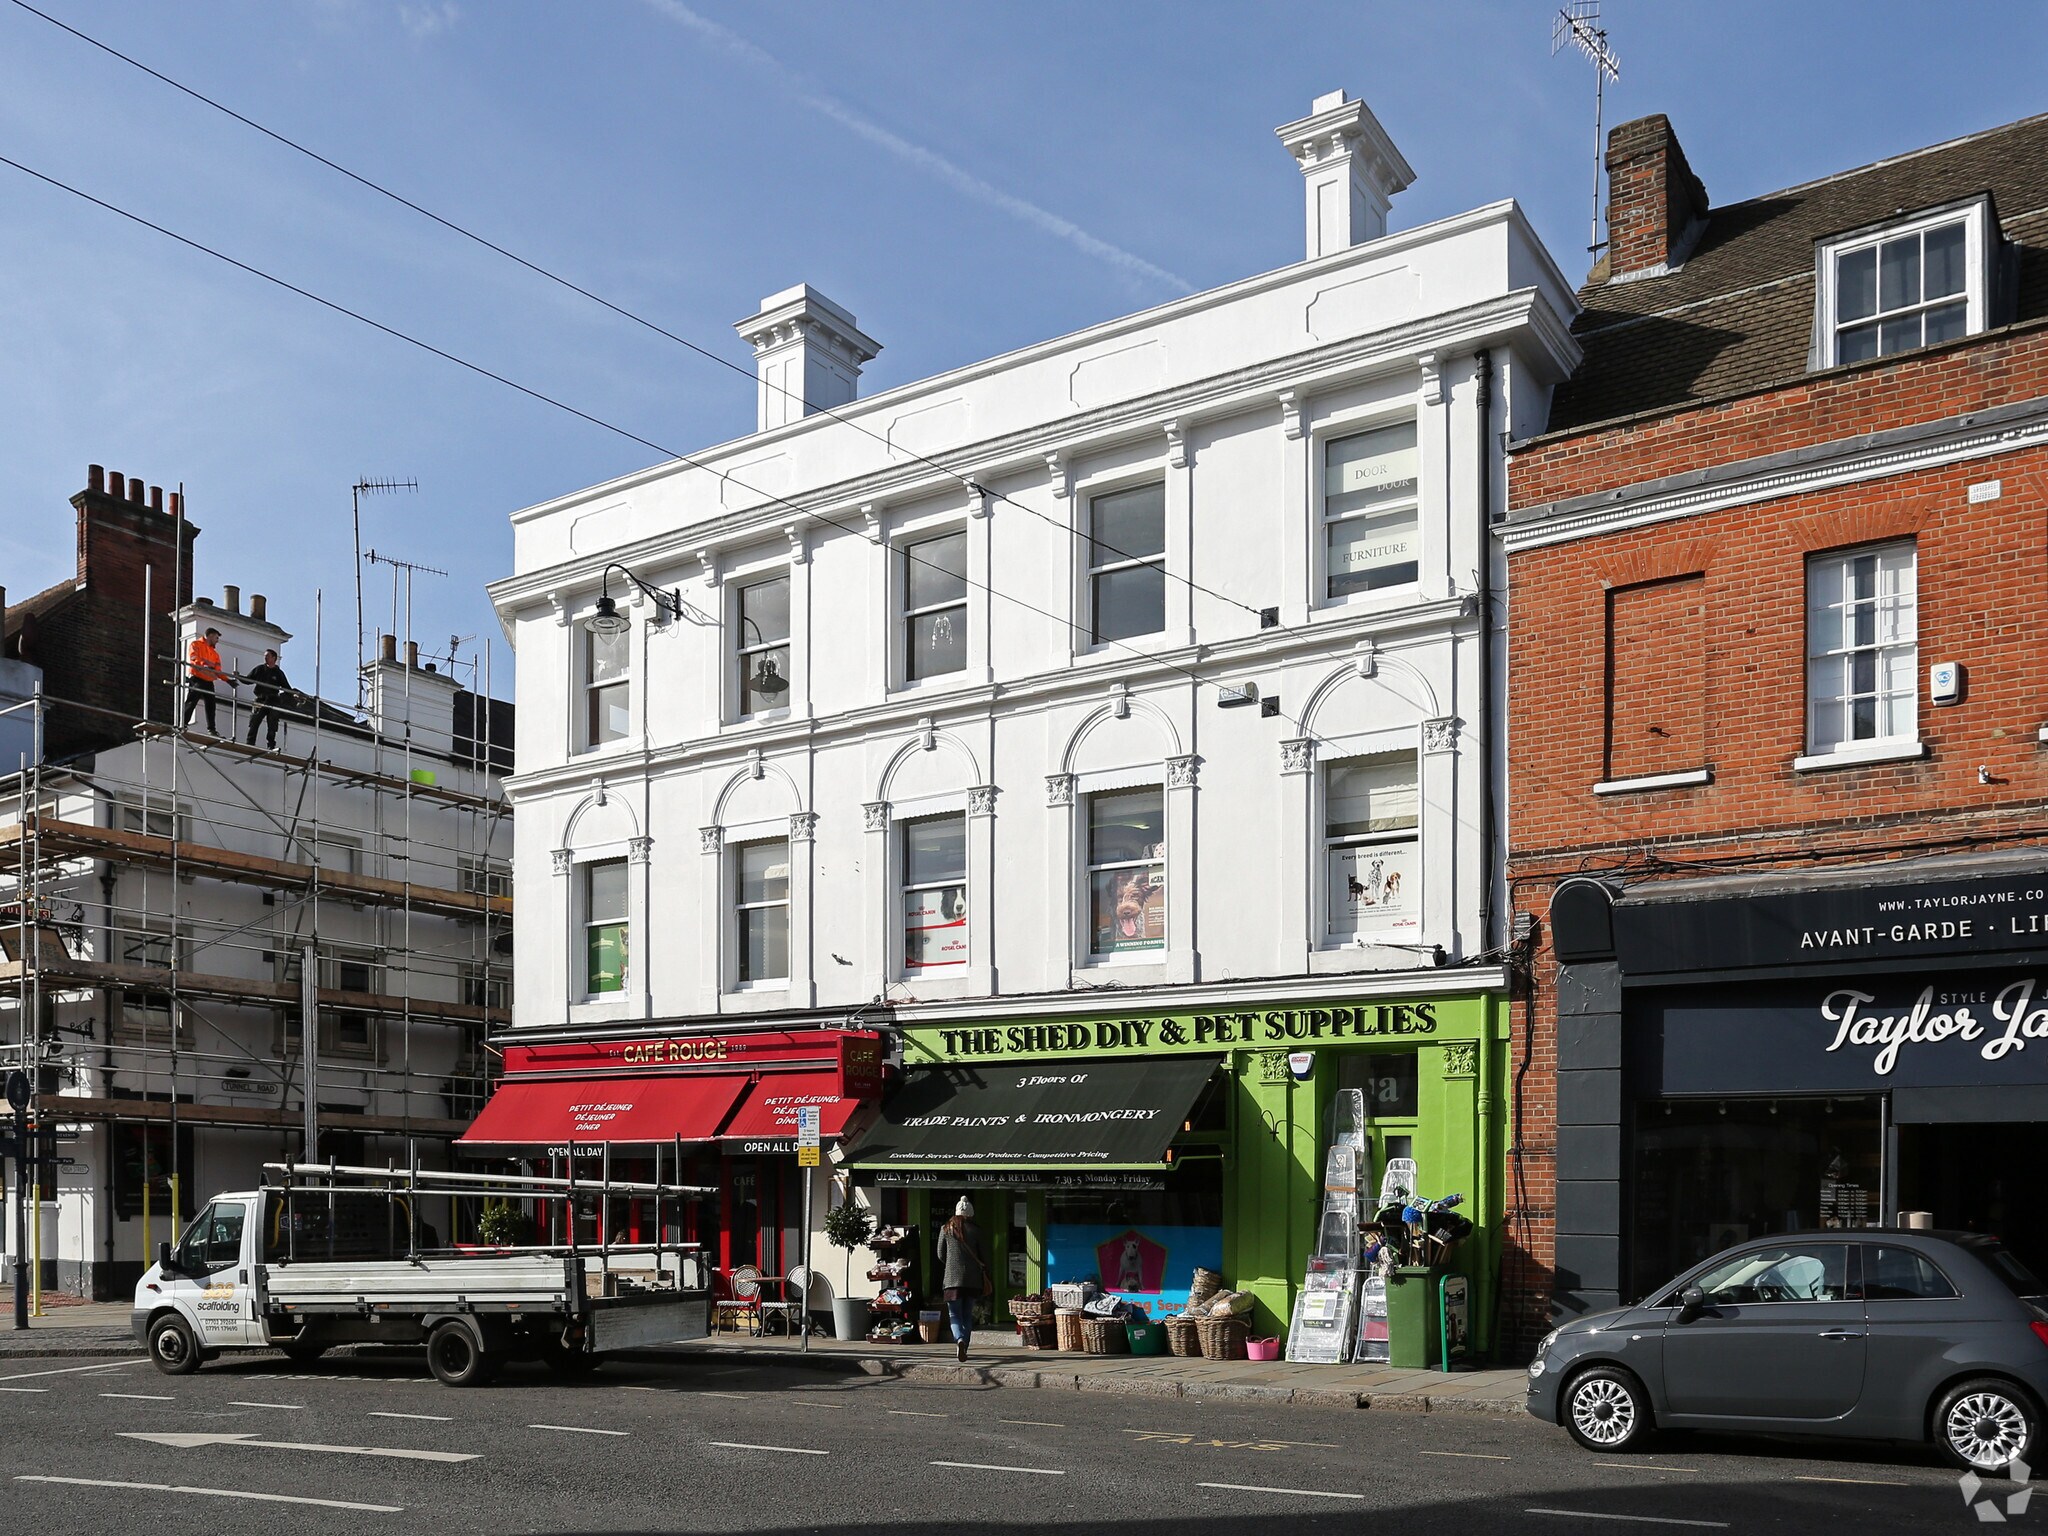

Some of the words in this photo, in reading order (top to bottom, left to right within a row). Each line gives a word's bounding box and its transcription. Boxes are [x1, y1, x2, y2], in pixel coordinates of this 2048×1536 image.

[1355, 464, 1388, 479] DOOR
[1343, 542, 1408, 563] FURNITURE
[1801, 920, 1973, 949] AVANT-GARDE
[1940, 992, 1986, 1004] STYLE
[939, 1028, 1004, 1056] THE
[1006, 1023, 1092, 1053] SHED
[1094, 1019, 1154, 1050] DIY
[1158, 1018, 1190, 1046] &
[1192, 1012, 1261, 1044] PET
[1264, 1003, 1437, 1041] SUPPLIES
[1821, 984, 1985, 1076] Taylor
[624, 1041, 664, 1062] CAFÉ
[669, 1040, 728, 1061] ROUGE
[850, 1050, 874, 1062] CAFÉ
[846, 1066, 879, 1078] ROUGE
[226, 1082, 250, 1091] TUNNEL
[1016, 1077, 1026, 1088] 3
[1028, 1074, 1068, 1086] Floors
[1070, 1074, 1088, 1084] Of
[568, 1104, 594, 1112] PETIT
[594, 1102, 634, 1112] DÉJEUNER
[764, 1097, 794, 1106] PETIT
[574, 1112, 616, 1121] DÉJEUNER
[902, 1116, 950, 1127] TRADE
[950, 1116, 1010, 1127] PAINTS
[1014, 1113, 1028, 1124] &
[1032, 1109, 1162, 1124] IRONMONGERY
[586, 1147, 603, 1156] DAY
[744, 1142, 770, 1152] OPEN
[772, 1142, 791, 1152] ALL
[1077, 1150, 1110, 1159] Pricing
[876, 1172, 901, 1181] OPEN
[906, 1174, 911, 1184] 7
[912, 1172, 938, 1182] DAYS
[998, 1174, 1006, 1182] &
[1008, 1174, 1040, 1182] RETAIL
[1085, 1174, 1118, 1184] Monday
[1124, 1174, 1150, 1184] Friday
[196, 1301, 240, 1314] scaffolding
